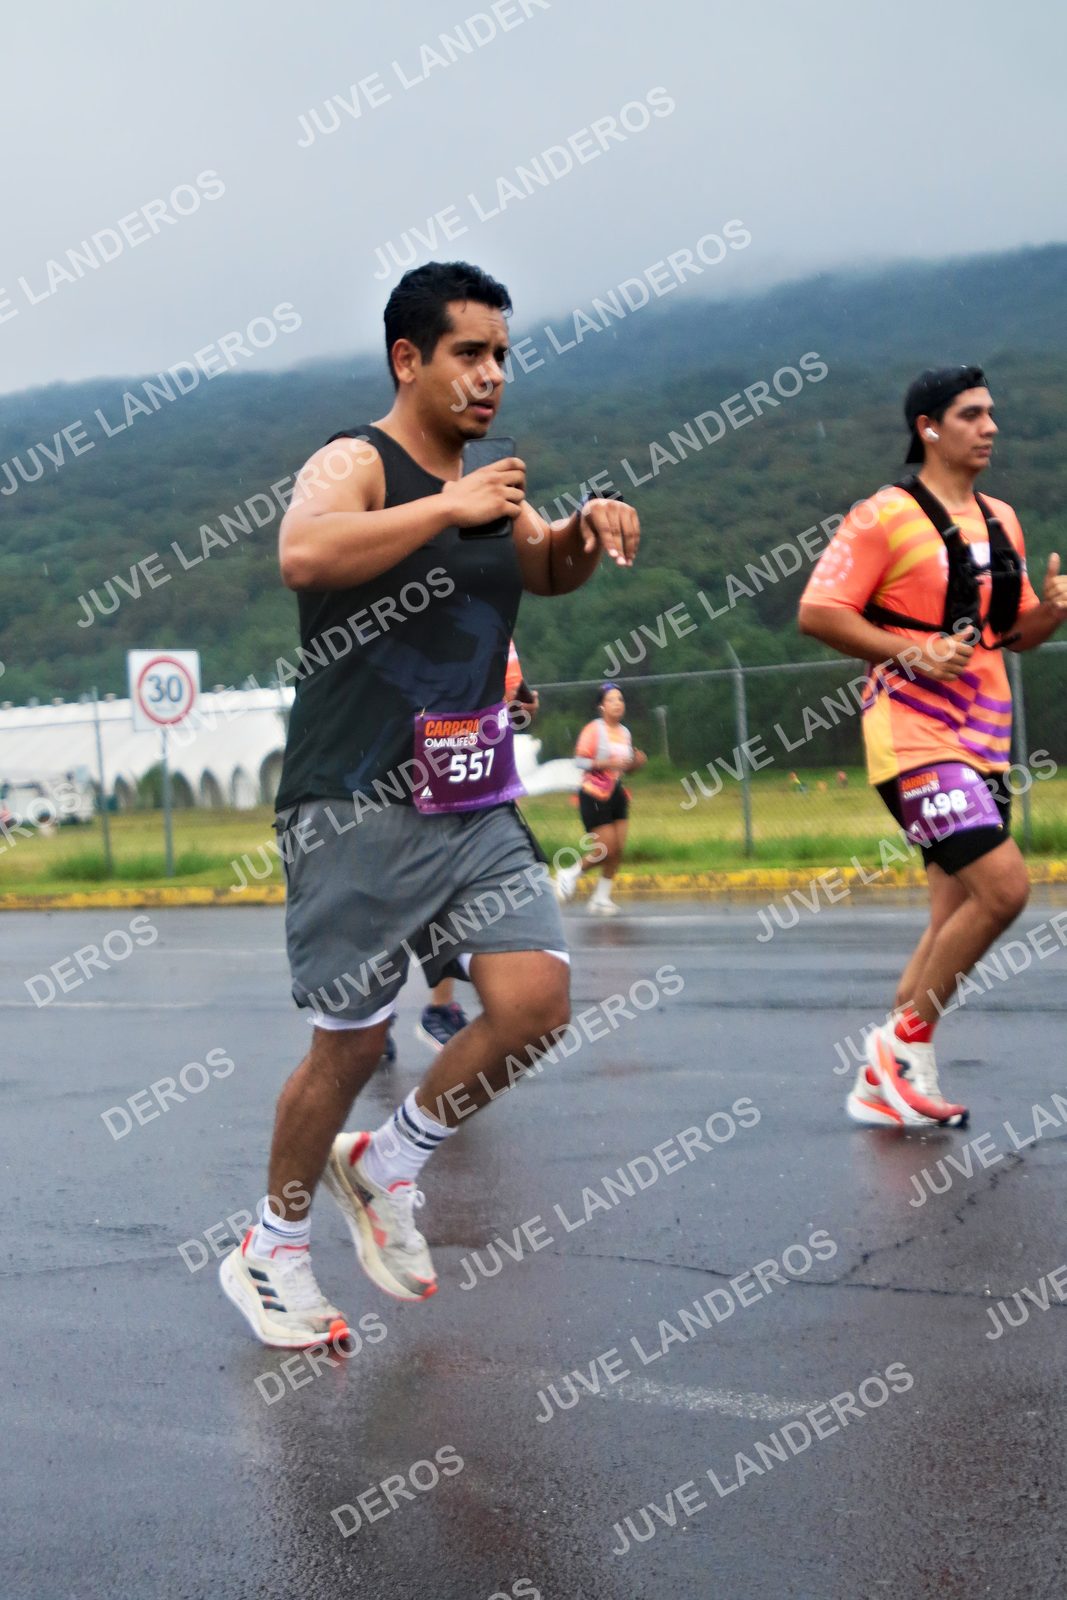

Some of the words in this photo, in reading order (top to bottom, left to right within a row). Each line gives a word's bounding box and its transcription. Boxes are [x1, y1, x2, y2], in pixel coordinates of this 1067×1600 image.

[147, 674, 183, 703] 30
[424, 737, 468, 748] OMNILIFE
[448, 748, 495, 783] 557
[922, 789, 968, 818] 498
